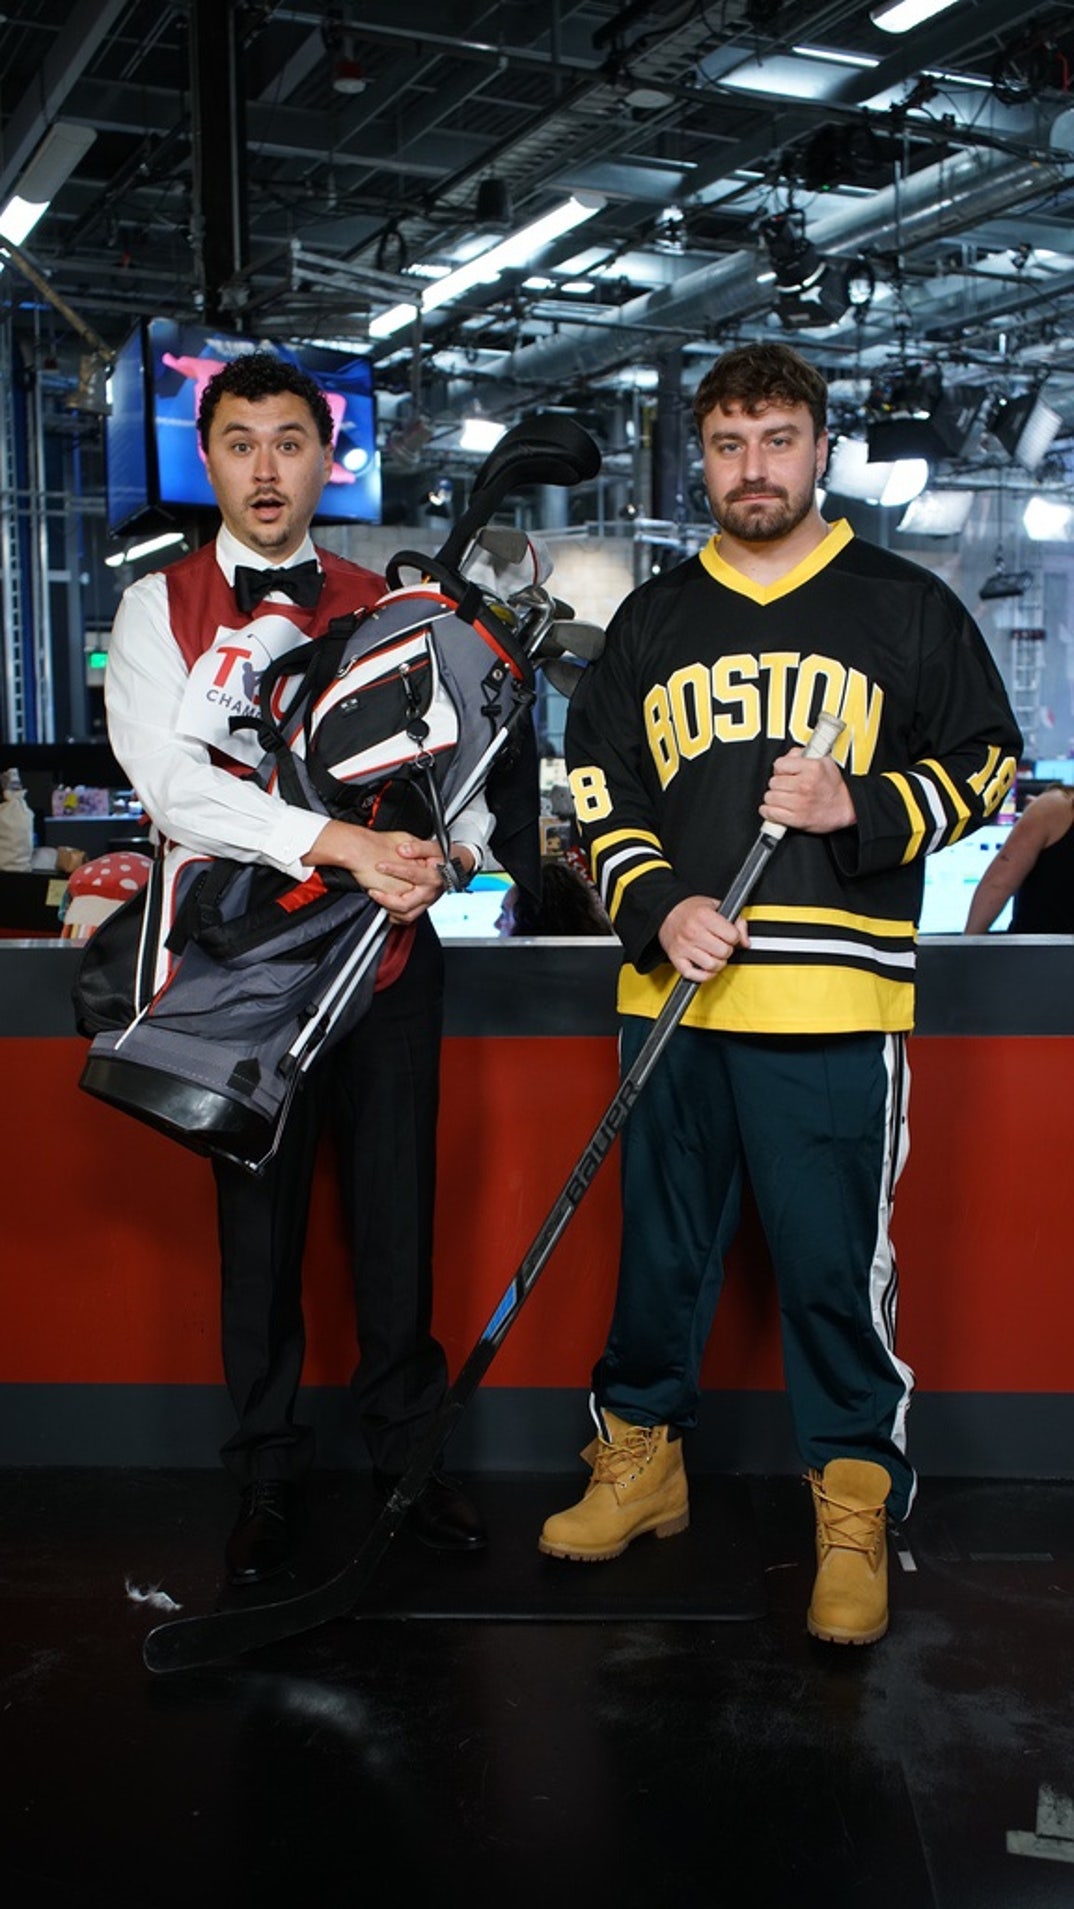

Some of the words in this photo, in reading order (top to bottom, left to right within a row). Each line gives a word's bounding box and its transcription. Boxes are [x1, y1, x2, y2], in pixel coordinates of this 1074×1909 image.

[643, 652, 884, 791] BOSTON
[567, 765, 614, 837] 8
[966, 745, 1017, 817] 18
